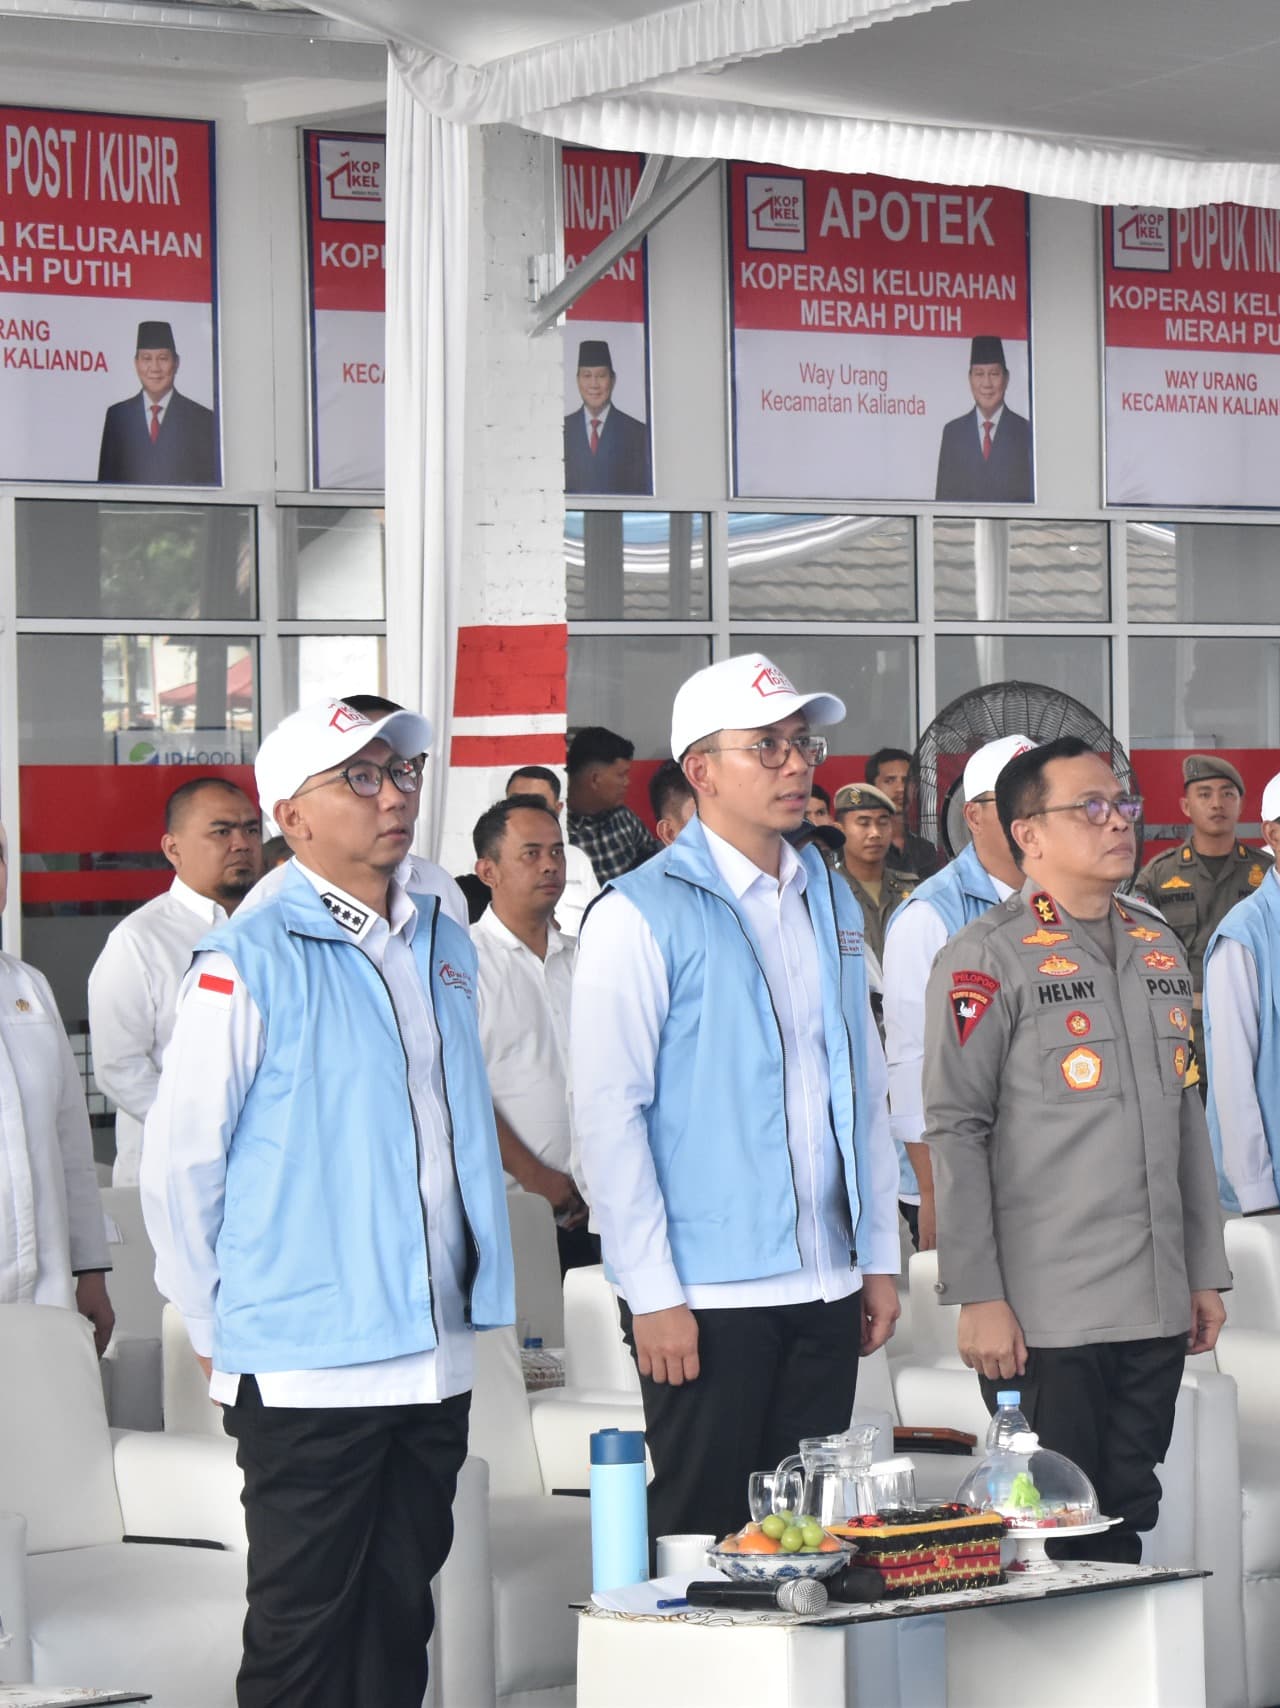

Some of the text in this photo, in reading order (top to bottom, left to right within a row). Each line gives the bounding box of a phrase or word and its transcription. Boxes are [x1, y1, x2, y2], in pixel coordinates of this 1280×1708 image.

[6, 125, 181, 206] POST / KURIR
[352, 161, 380, 173] KOP
[352, 176, 379, 188] KEL
[774, 195, 799, 207] KOP
[774, 208, 799, 221] KEL
[819, 187, 995, 247] APOTEK
[1140, 213, 1164, 225] KOP
[15, 222, 202, 258] KELURAHAN
[1141, 226, 1162, 239] KEL
[1176, 206, 1250, 272] PUPUK
[43, 258, 132, 288] PUTIH
[741, 262, 1016, 301] KOPERASI KELURAHAN
[1109, 285, 1227, 314] KOPERASI
[801, 299, 962, 332] MERAH PUTIH
[1165, 318, 1247, 344] MERAH
[4, 347, 108, 373] KALIANDA
[800, 362, 888, 391] Way Urang
[1165, 370, 1258, 392] WAY URANG
[761, 389, 926, 416] Kecamatan Kalianda
[1122, 392, 1219, 414] KECAMATAN
[1038, 978, 1192, 1004] HELMY POLRI
